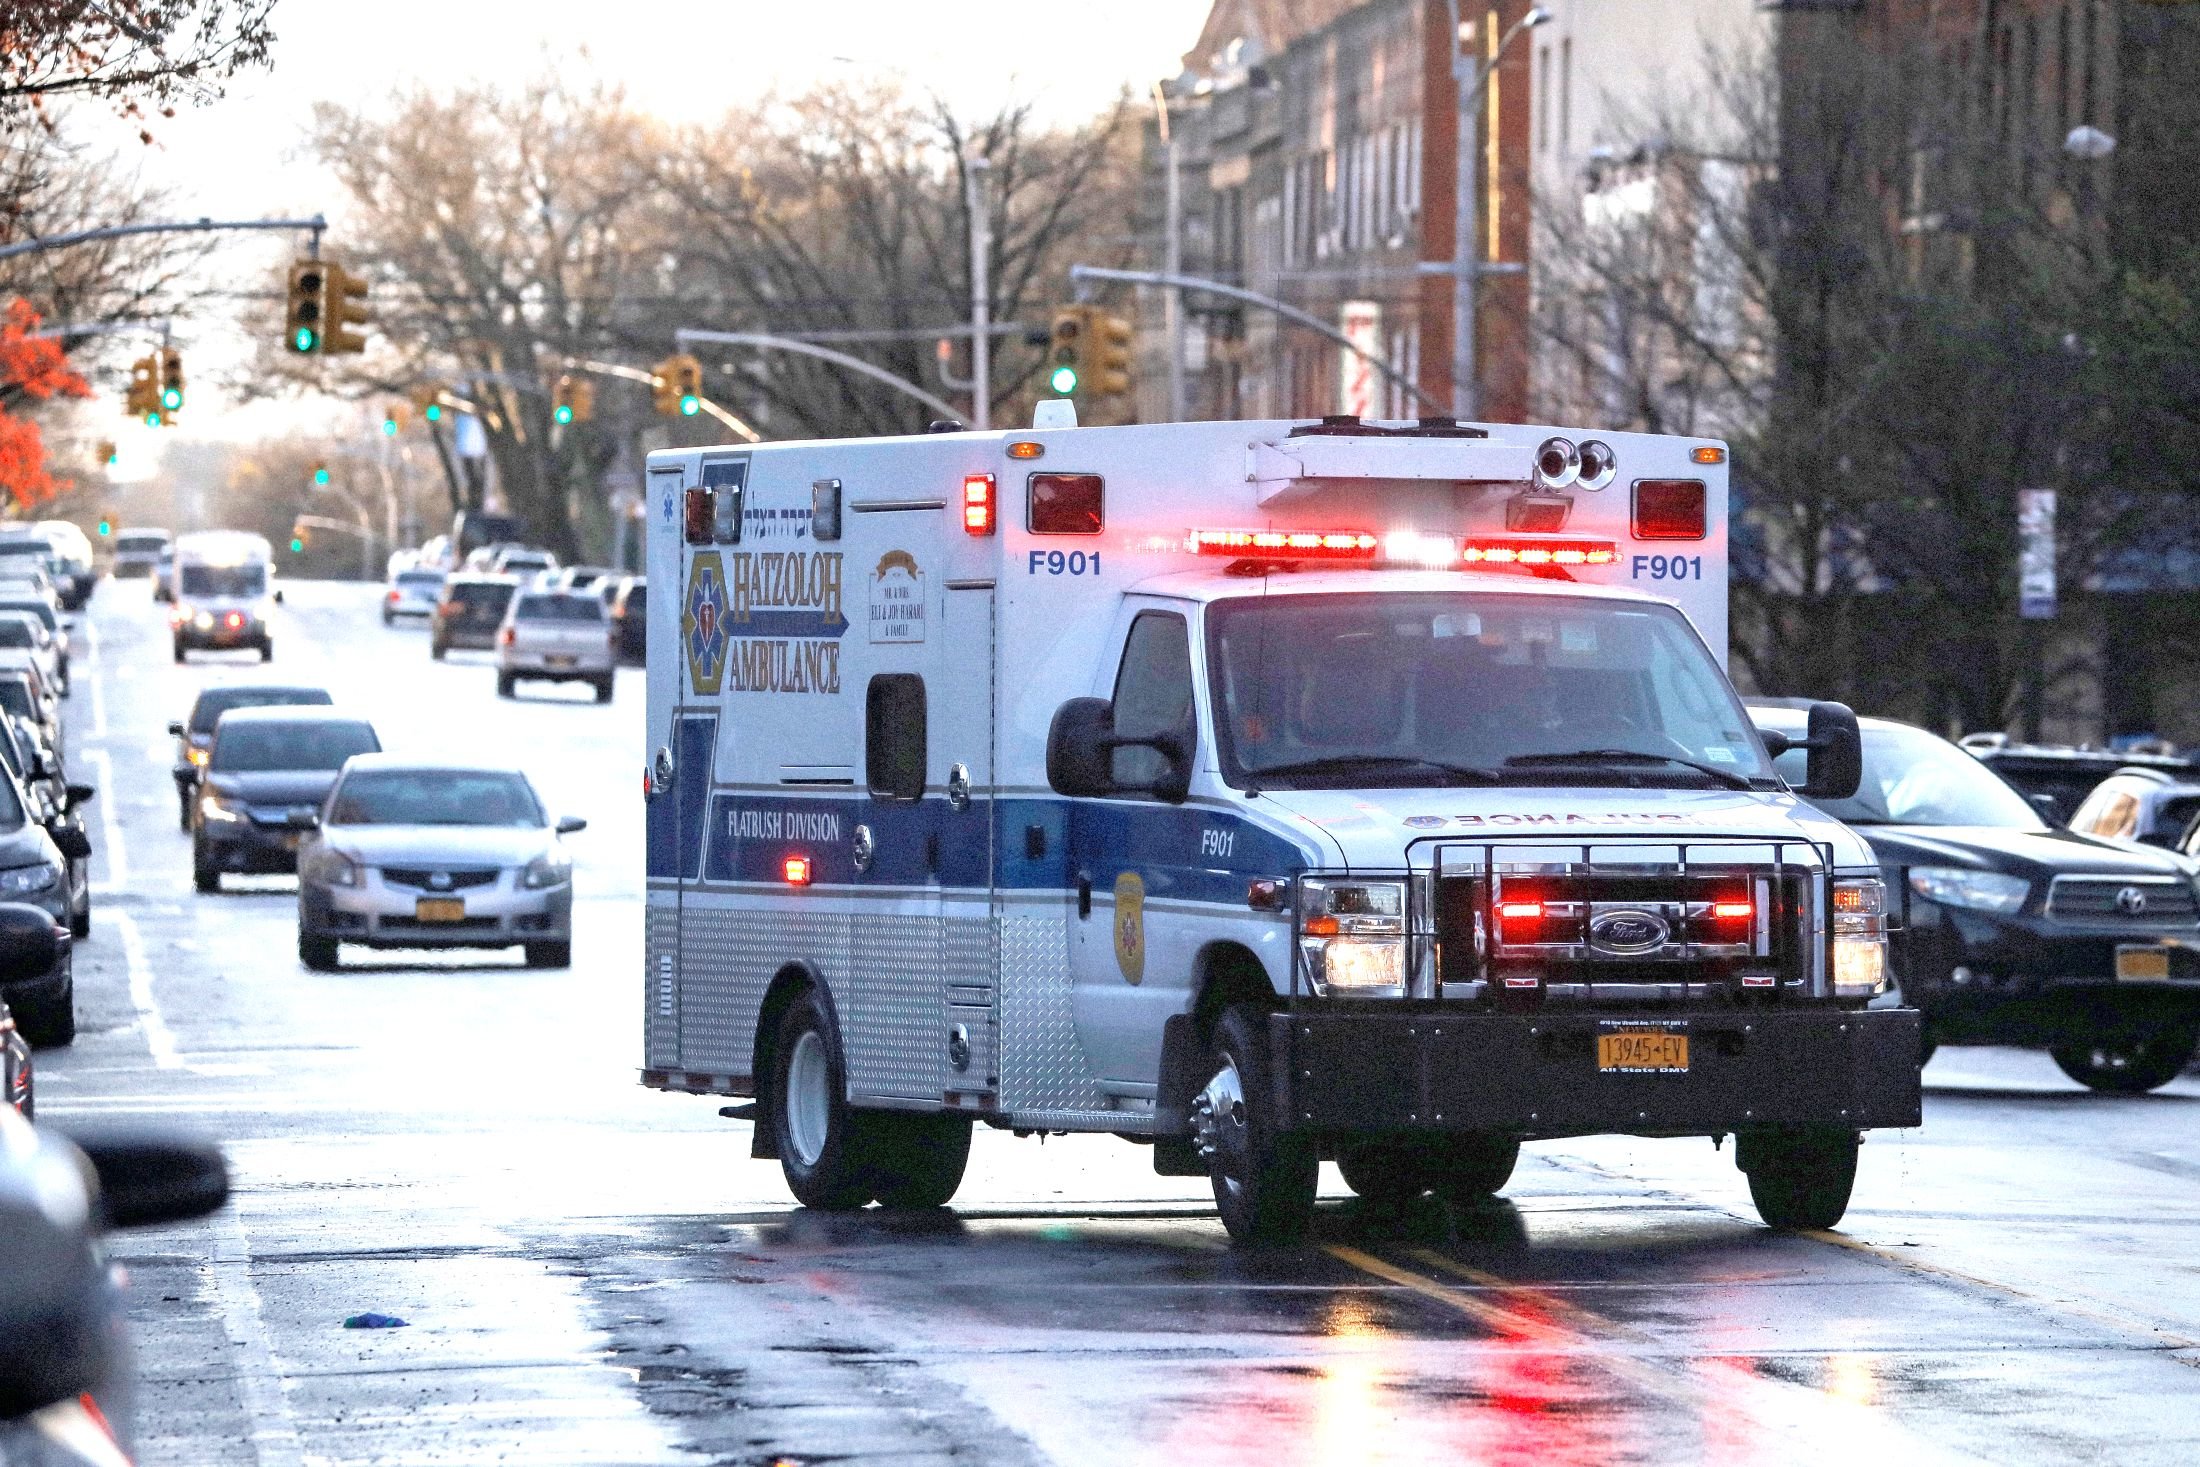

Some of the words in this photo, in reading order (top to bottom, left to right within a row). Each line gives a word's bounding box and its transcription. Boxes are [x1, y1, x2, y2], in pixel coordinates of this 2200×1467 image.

[1029, 550, 1100, 576] F901
[1632, 555, 1702, 580] F901
[732, 551, 844, 624] HATZOLOH
[729, 640, 840, 693] AMBULANCE
[728, 811, 782, 839] FLATBUSH
[786, 812, 839, 842] DIVISION
[1201, 829, 1235, 858] F901
[1608, 921, 1648, 940] Ford
